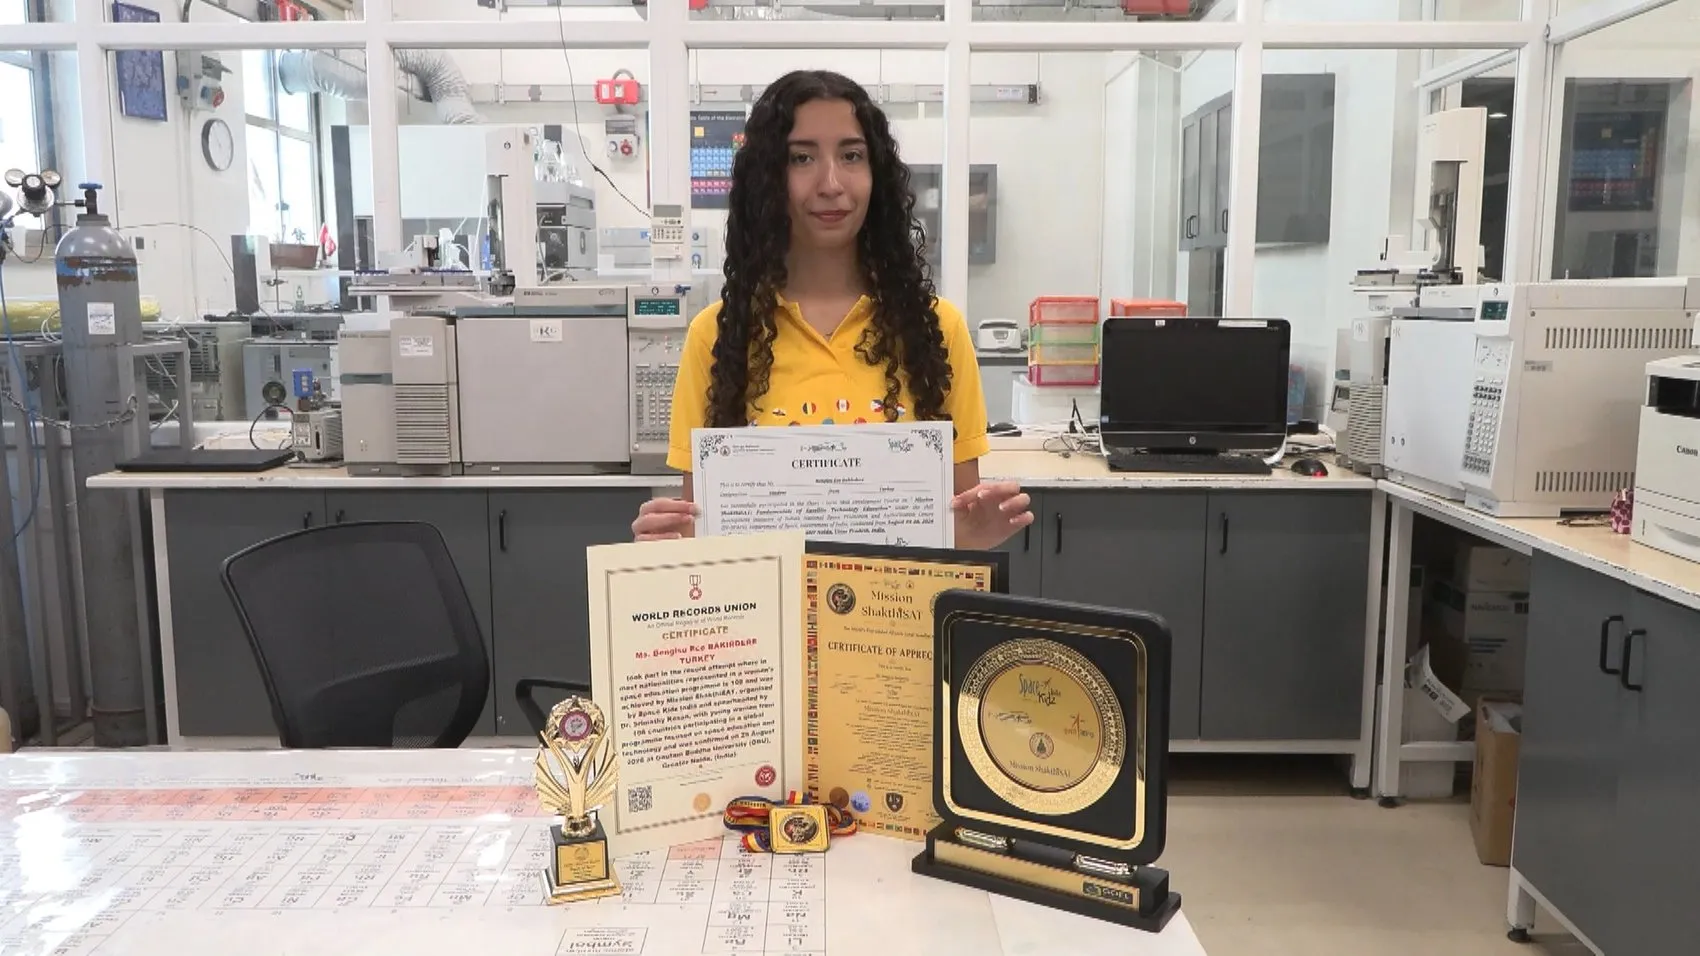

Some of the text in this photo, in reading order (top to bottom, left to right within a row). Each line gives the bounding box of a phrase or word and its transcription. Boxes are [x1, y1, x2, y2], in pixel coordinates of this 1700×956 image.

[791, 458, 862, 469] CERTIFICATE
[871, 590, 913, 605] Mission
[632, 611, 670, 622] WORLD
[672, 606, 721, 618] RECORDS
[724, 602, 757, 613] UNION
[861, 606, 922, 621] ShakthiSAT
[662, 626, 728, 640] CERTIFICATE
[680, 654, 716, 664] TURKEY
[828, 642, 932, 660] CERTIFICATE OF APPREC
[626, 674, 642, 682] took
[644, 672, 659, 680] part
[684, 664, 706, 674] record
[708, 662, 736, 670] attempt
[639, 677, 684, 689] nationalities
[686, 672, 728, 682] represented
[620, 692, 642, 702] space
[644, 686, 680, 698] education
[682, 681, 720, 694] programme
[1019, 674, 1040, 698] Space
[622, 700, 654, 710] achieved
[666, 696, 694, 704] Mission
[740, 684, 773, 694] organised
[638, 708, 660, 718] Space
[680, 703, 698, 711] India
[710, 708, 731, 717] young
[732, 704, 758, 712] women
[758, 702, 775, 710] from
[648, 724, 682, 734] countries
[682, 717, 728, 730] participating
[743, 712, 764, 721] global
[622, 736, 662, 748] programme
[664, 732, 692, 741] focused
[704, 727, 725, 736] space
[726, 720, 760, 732] education
[622, 746, 662, 758] technology
[664, 742, 676, 750] and
[694, 734, 729, 746] confirmed
[751, 728, 775, 736] August
[656, 750, 684, 760] Gautam
[685, 746, 712, 756] Buddha
[712, 741, 748, 752] University
[662, 760, 689, 768] Greater
[714, 751, 737, 762] (India)
[1010, 760, 1034, 772] Mission
